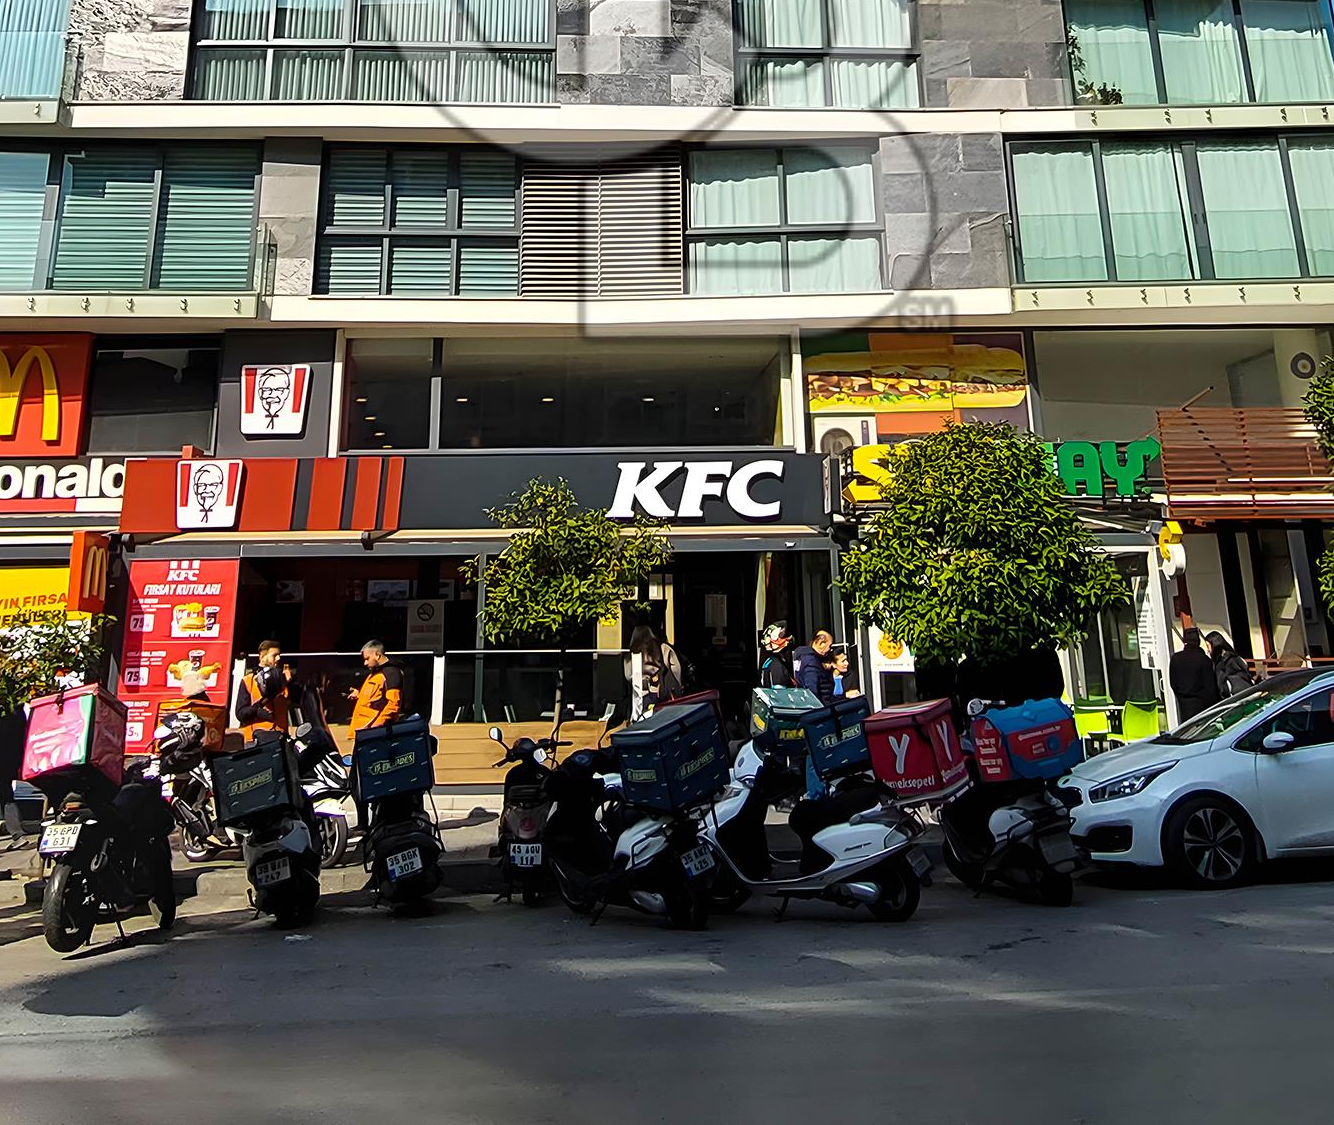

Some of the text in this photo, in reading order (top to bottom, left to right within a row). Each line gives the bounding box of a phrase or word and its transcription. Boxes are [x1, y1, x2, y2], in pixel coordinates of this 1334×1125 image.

[605, 459, 785, 519] KFC
[167, 570, 200, 581] KFC
[21, 592, 68, 608] FIRSA
[46, 827, 59, 837] 35
[388, 848, 418, 868] 35 BGK
[681, 853, 693, 866] 35
[397, 860, 416, 876] 302
